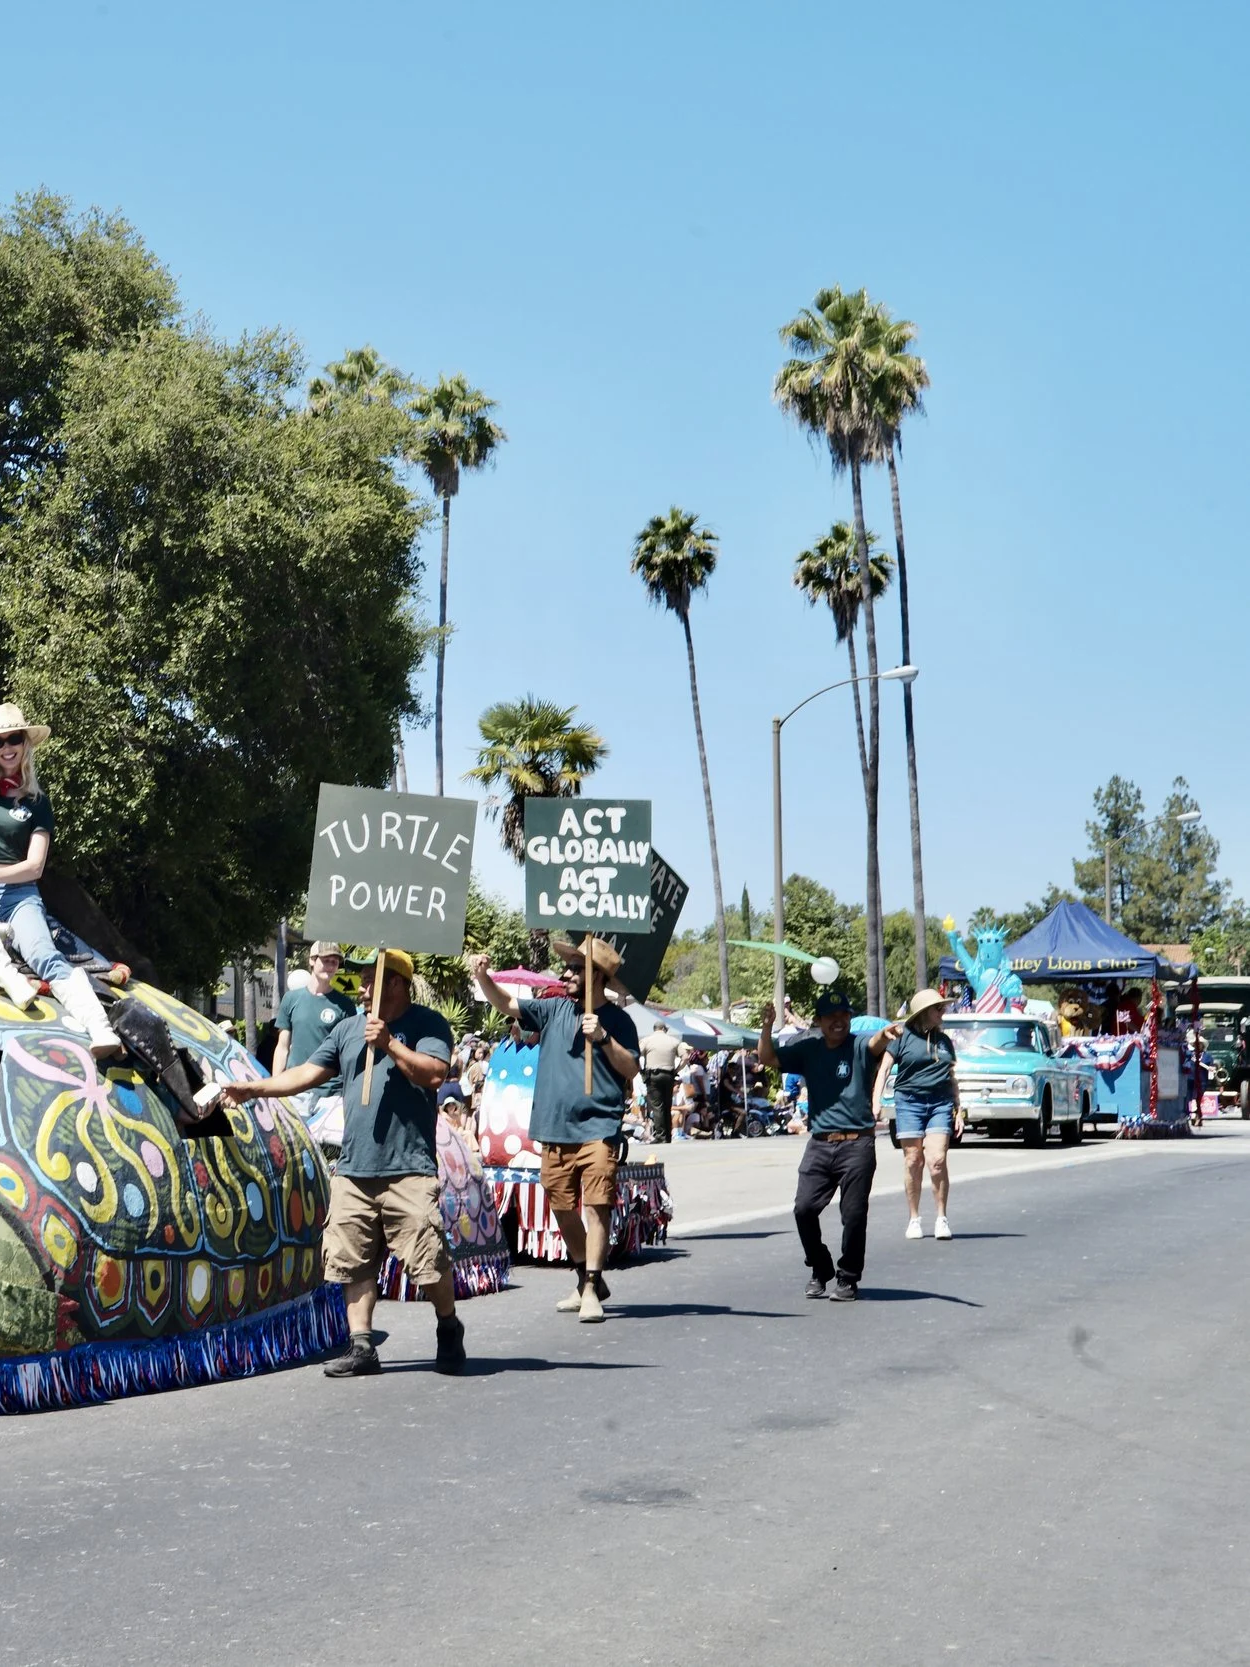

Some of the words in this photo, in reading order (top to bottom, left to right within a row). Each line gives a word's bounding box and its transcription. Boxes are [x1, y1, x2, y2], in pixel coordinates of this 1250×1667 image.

[558, 807, 627, 837] ACT
[319, 811, 470, 874] TURTLE
[527, 835, 650, 867] GLOBALLY
[559, 867, 618, 893] ACT
[330, 875, 446, 922] POWER
[539, 892, 650, 920] LOCALLY
[1047, 955, 1091, 971] Lions
[1097, 958, 1137, 971] Club
